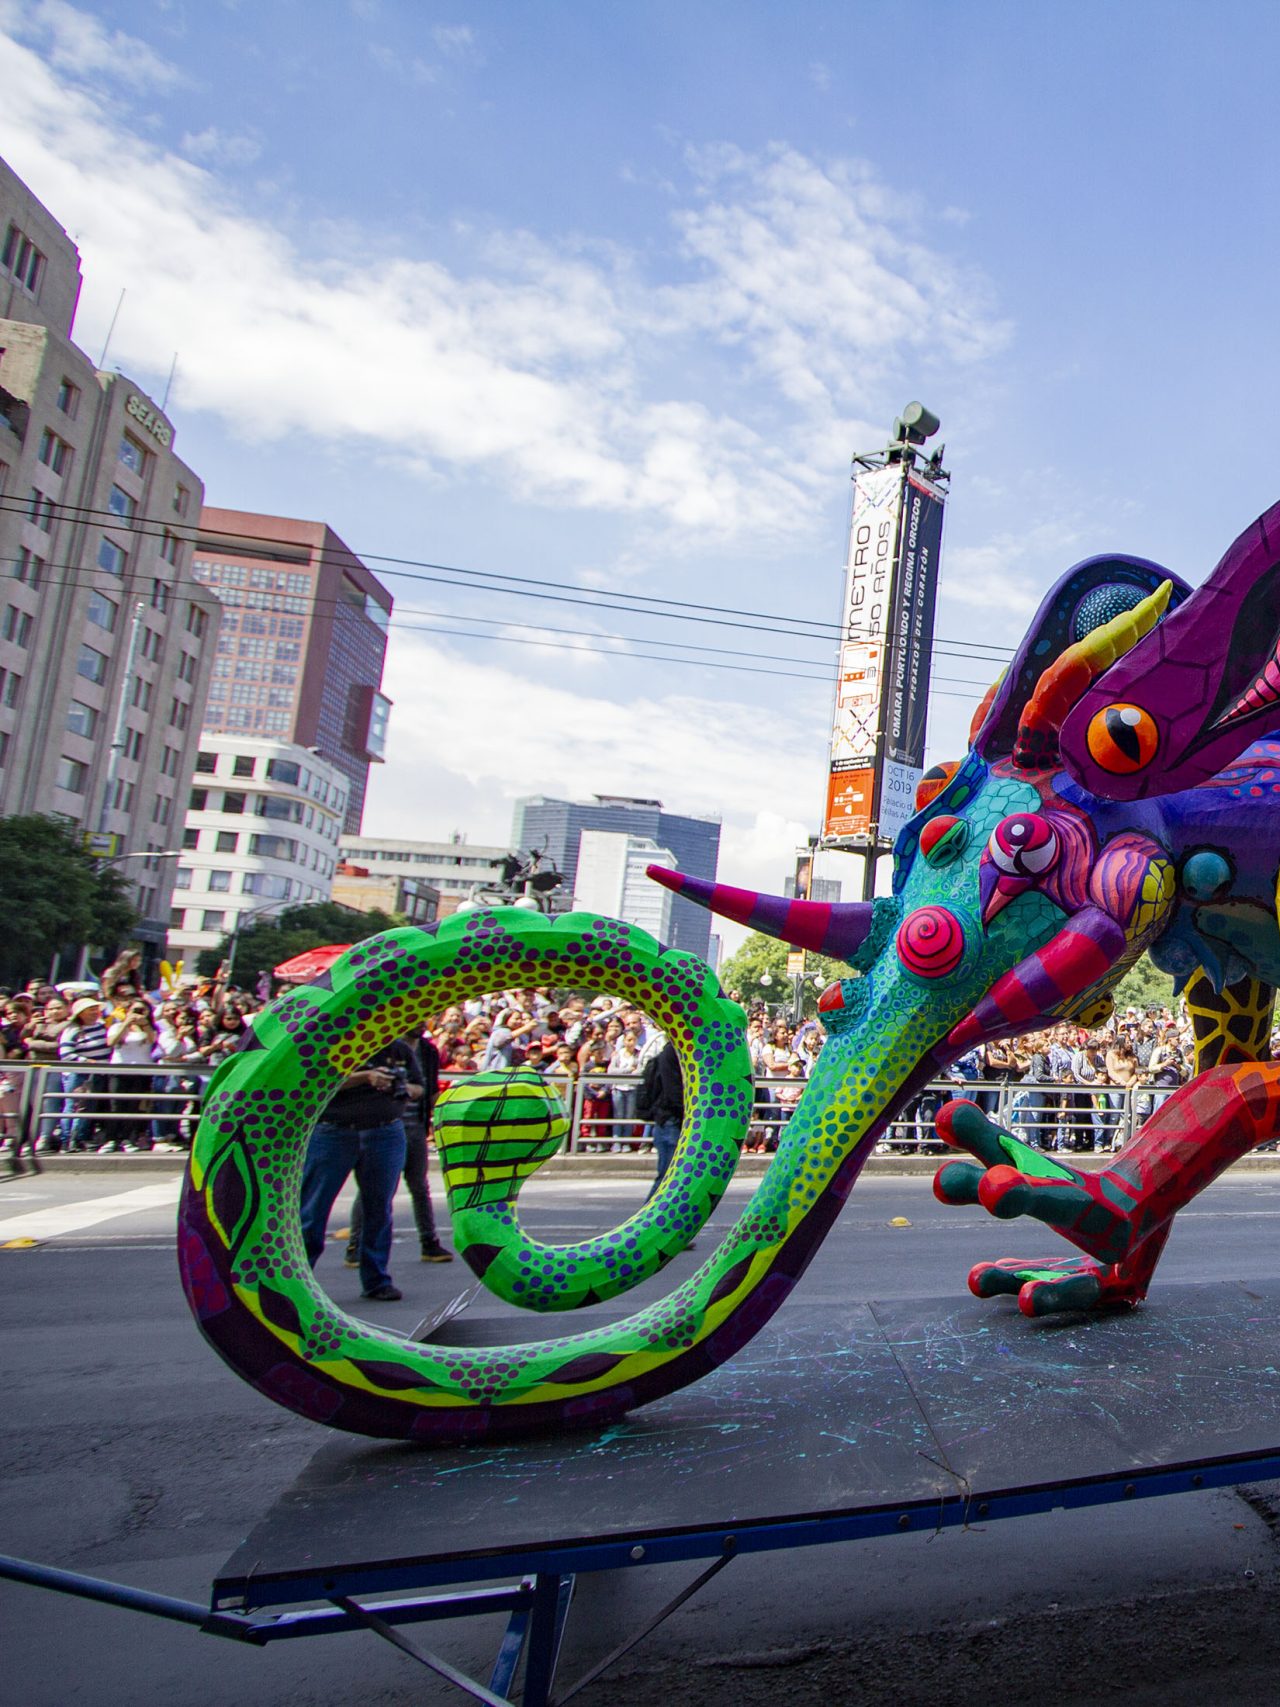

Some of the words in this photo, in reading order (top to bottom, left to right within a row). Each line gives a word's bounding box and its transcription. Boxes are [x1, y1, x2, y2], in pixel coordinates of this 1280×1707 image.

[127, 395, 171, 447] SEARS
[909, 497, 922, 548] OROZCO
[903, 552, 915, 598] REGINA
[917, 546, 929, 607] CORAZÓN
[868, 603, 882, 638] 50
[902, 599, 911, 608] Y
[915, 614, 923, 637] DEL
[895, 611, 910, 689] PORTUONDO
[910, 642, 921, 701] PEDAZOS
[892, 692, 904, 738] OMARA
[887, 765, 905, 778] OCT
[906, 770, 915, 781] 16
[888, 778, 912, 794] 2019
